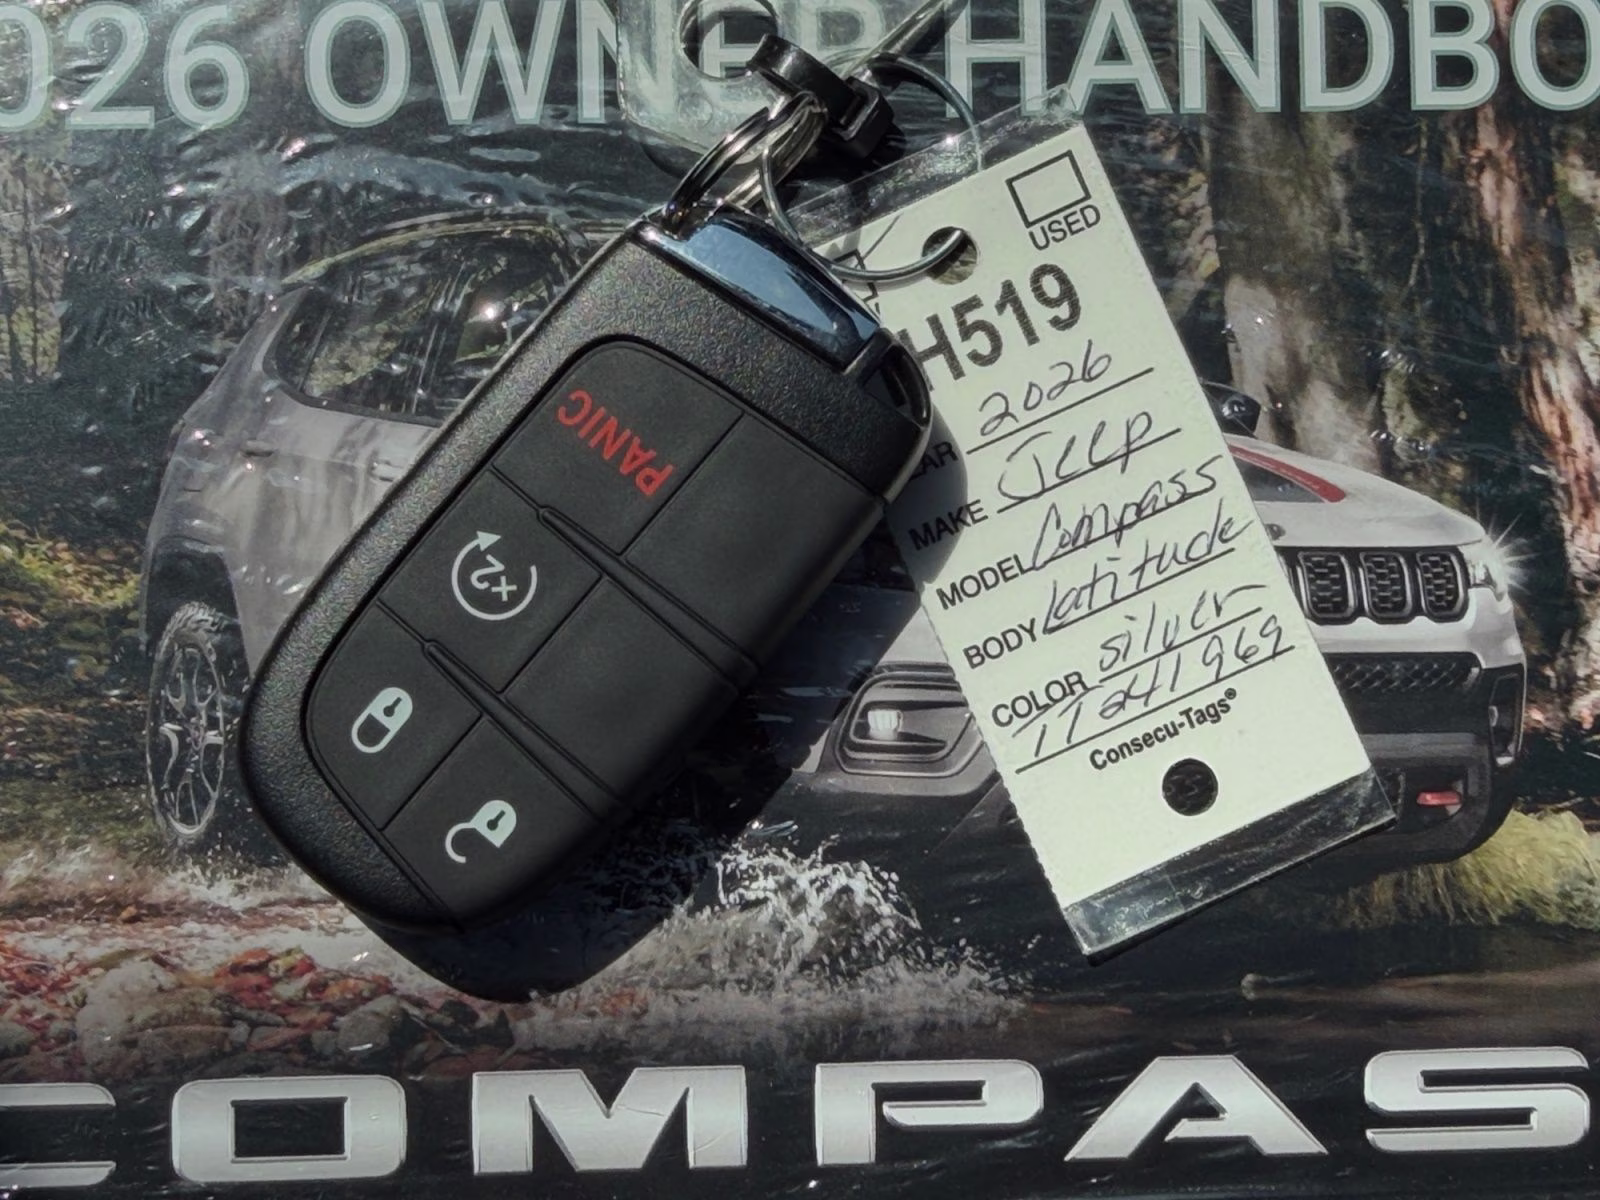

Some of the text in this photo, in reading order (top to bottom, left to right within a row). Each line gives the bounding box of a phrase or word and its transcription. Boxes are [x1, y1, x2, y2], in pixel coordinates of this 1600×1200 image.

[944, 0, 1600, 118] HANDBO
[1029, 204, 1101, 251] USED
[897, 263, 1082, 391] H519
[979, 338, 1112, 436] 2026
[557, 389, 674, 496] PANIC
[908, 499, 989, 551] MAKE
[1032, 455, 1223, 572] Compass
[936, 554, 1035, 610] MODEL
[962, 618, 1037, 669] BODY
[991, 671, 1090, 727] COLOR
